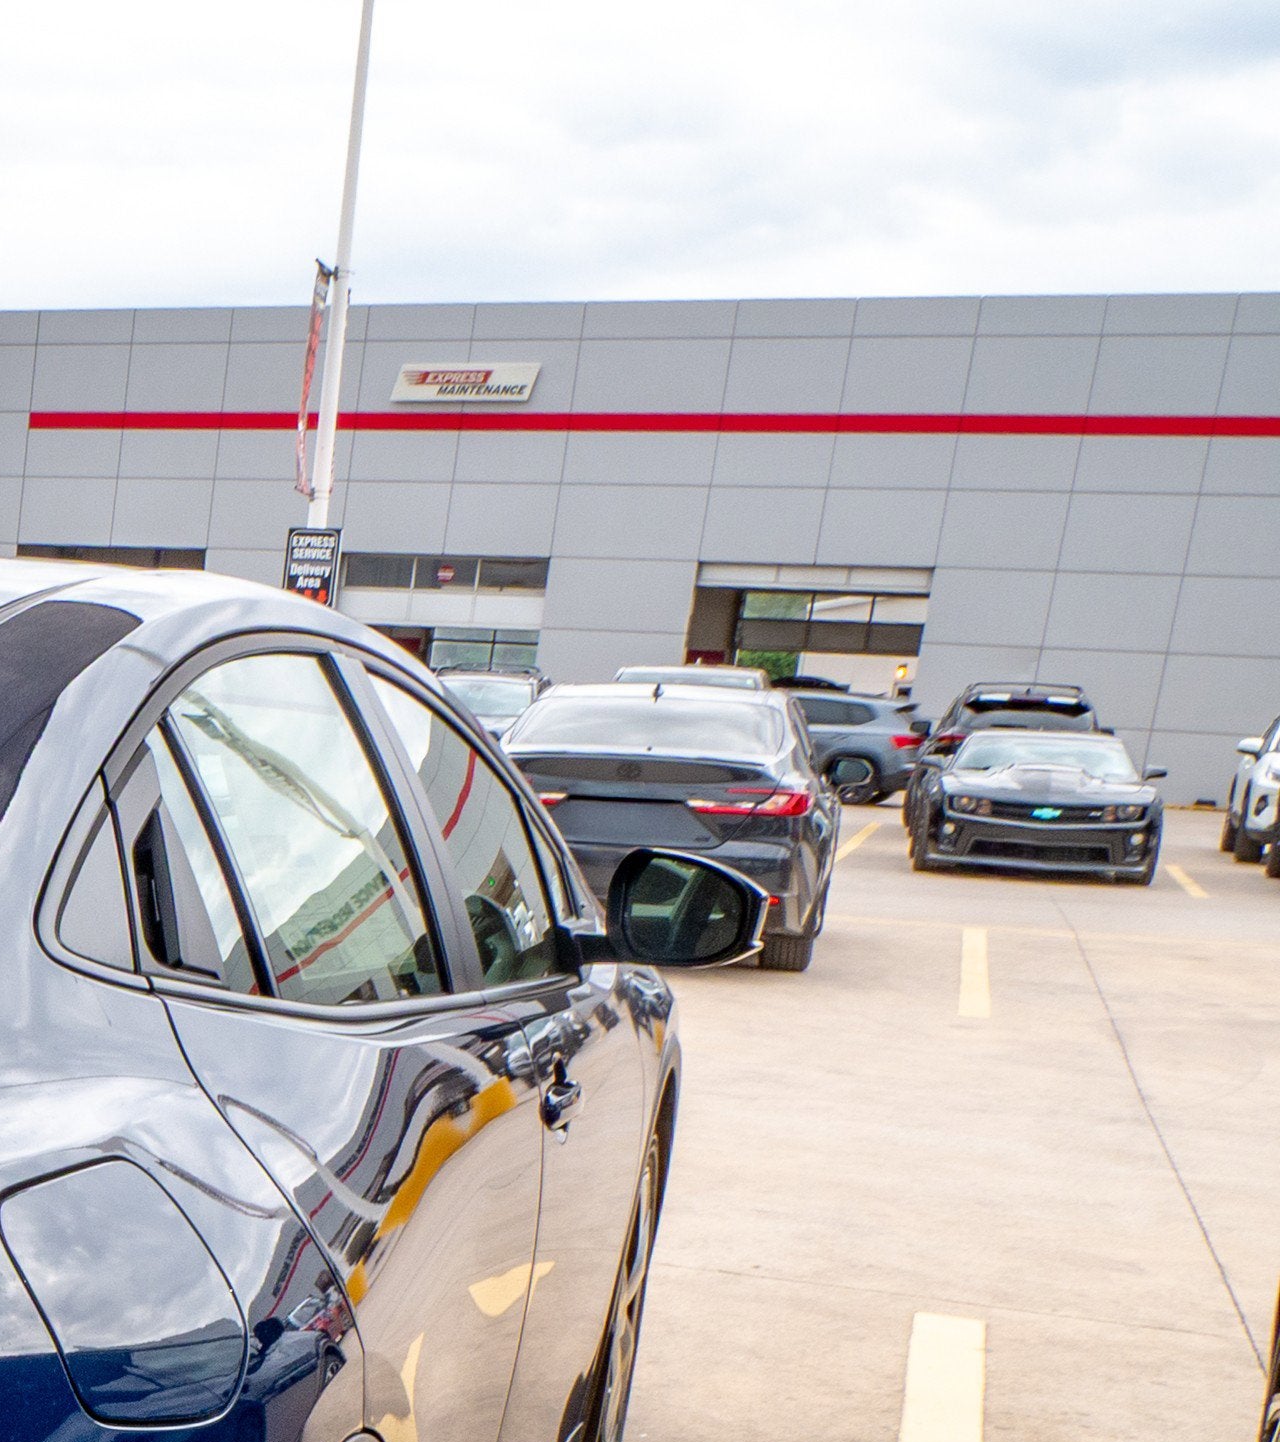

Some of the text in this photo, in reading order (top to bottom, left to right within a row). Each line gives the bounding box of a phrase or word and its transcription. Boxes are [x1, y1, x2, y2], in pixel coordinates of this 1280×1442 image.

[425, 372, 487, 384] EXPRESS
[437, 385, 527, 396] MAINTENANCE
[292, 536, 335, 548] EXPRESS
[292, 548, 332, 560] SERVICE
[290, 563, 331, 578] Delivery
[296, 576, 321, 589] Area
